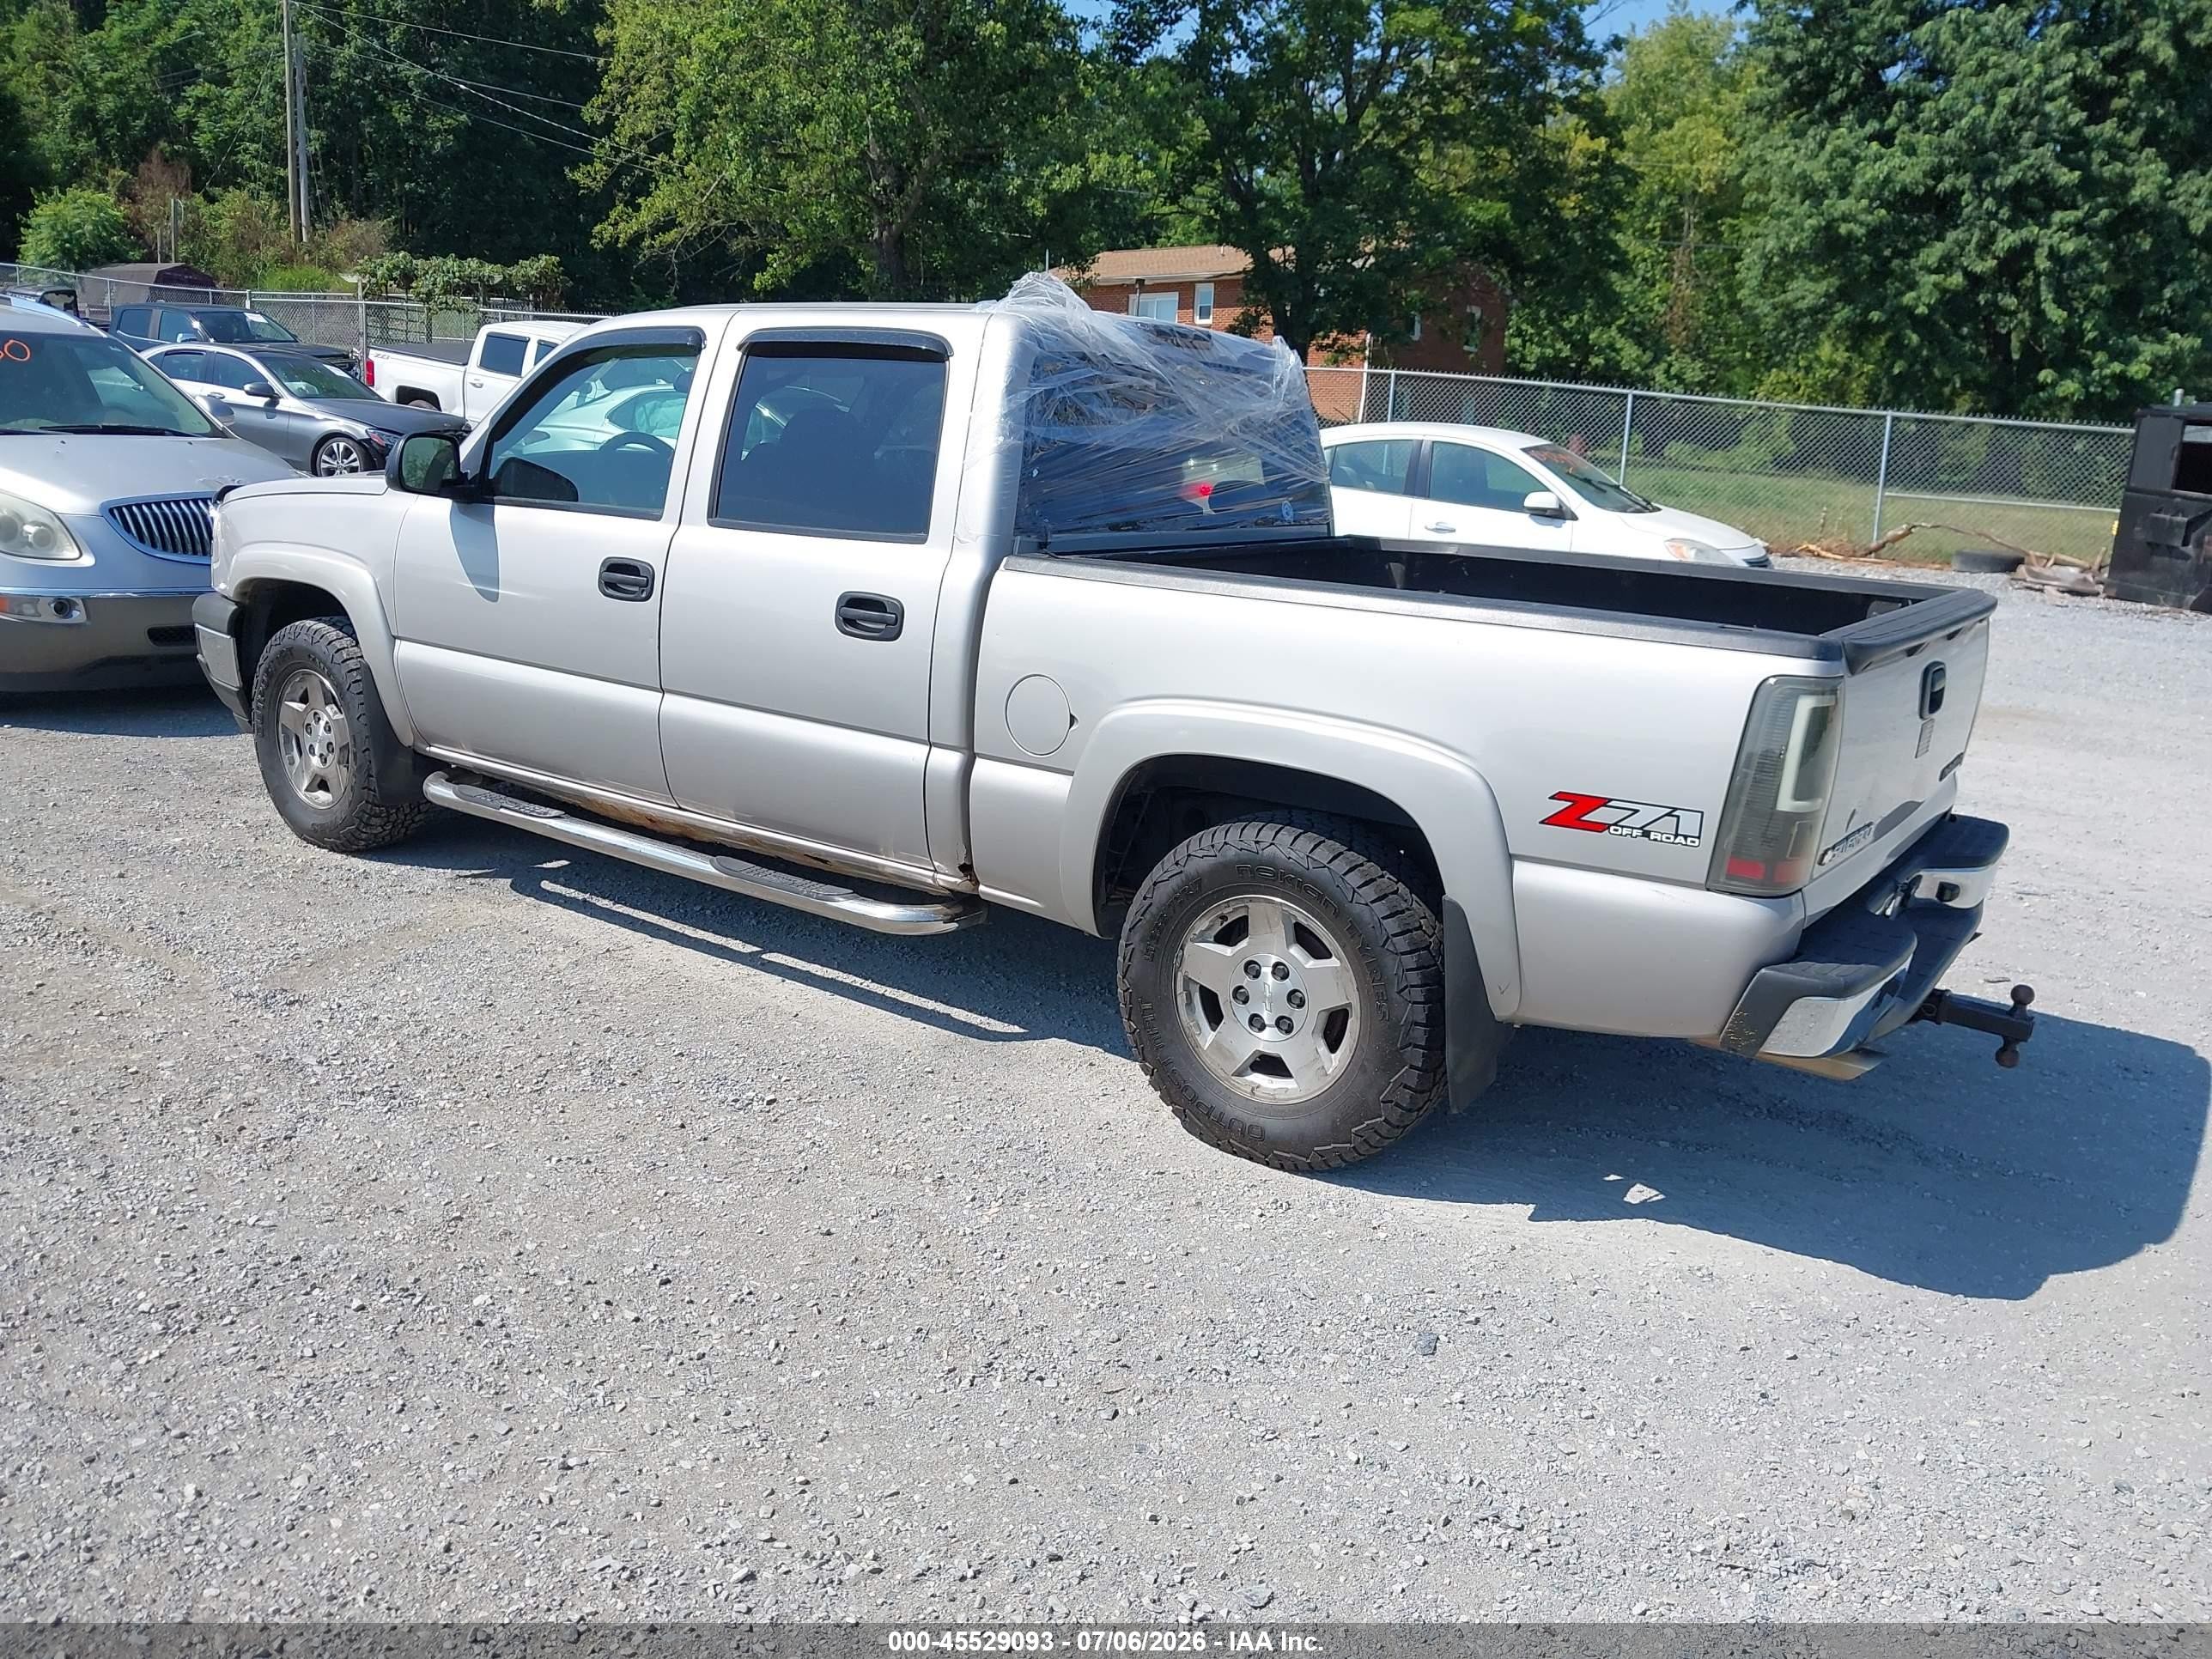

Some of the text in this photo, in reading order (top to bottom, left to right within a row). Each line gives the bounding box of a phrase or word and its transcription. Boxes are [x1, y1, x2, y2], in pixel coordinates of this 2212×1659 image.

[1539, 791, 1704, 838] Z71
[1607, 824, 1700, 848] OFF ROAD
